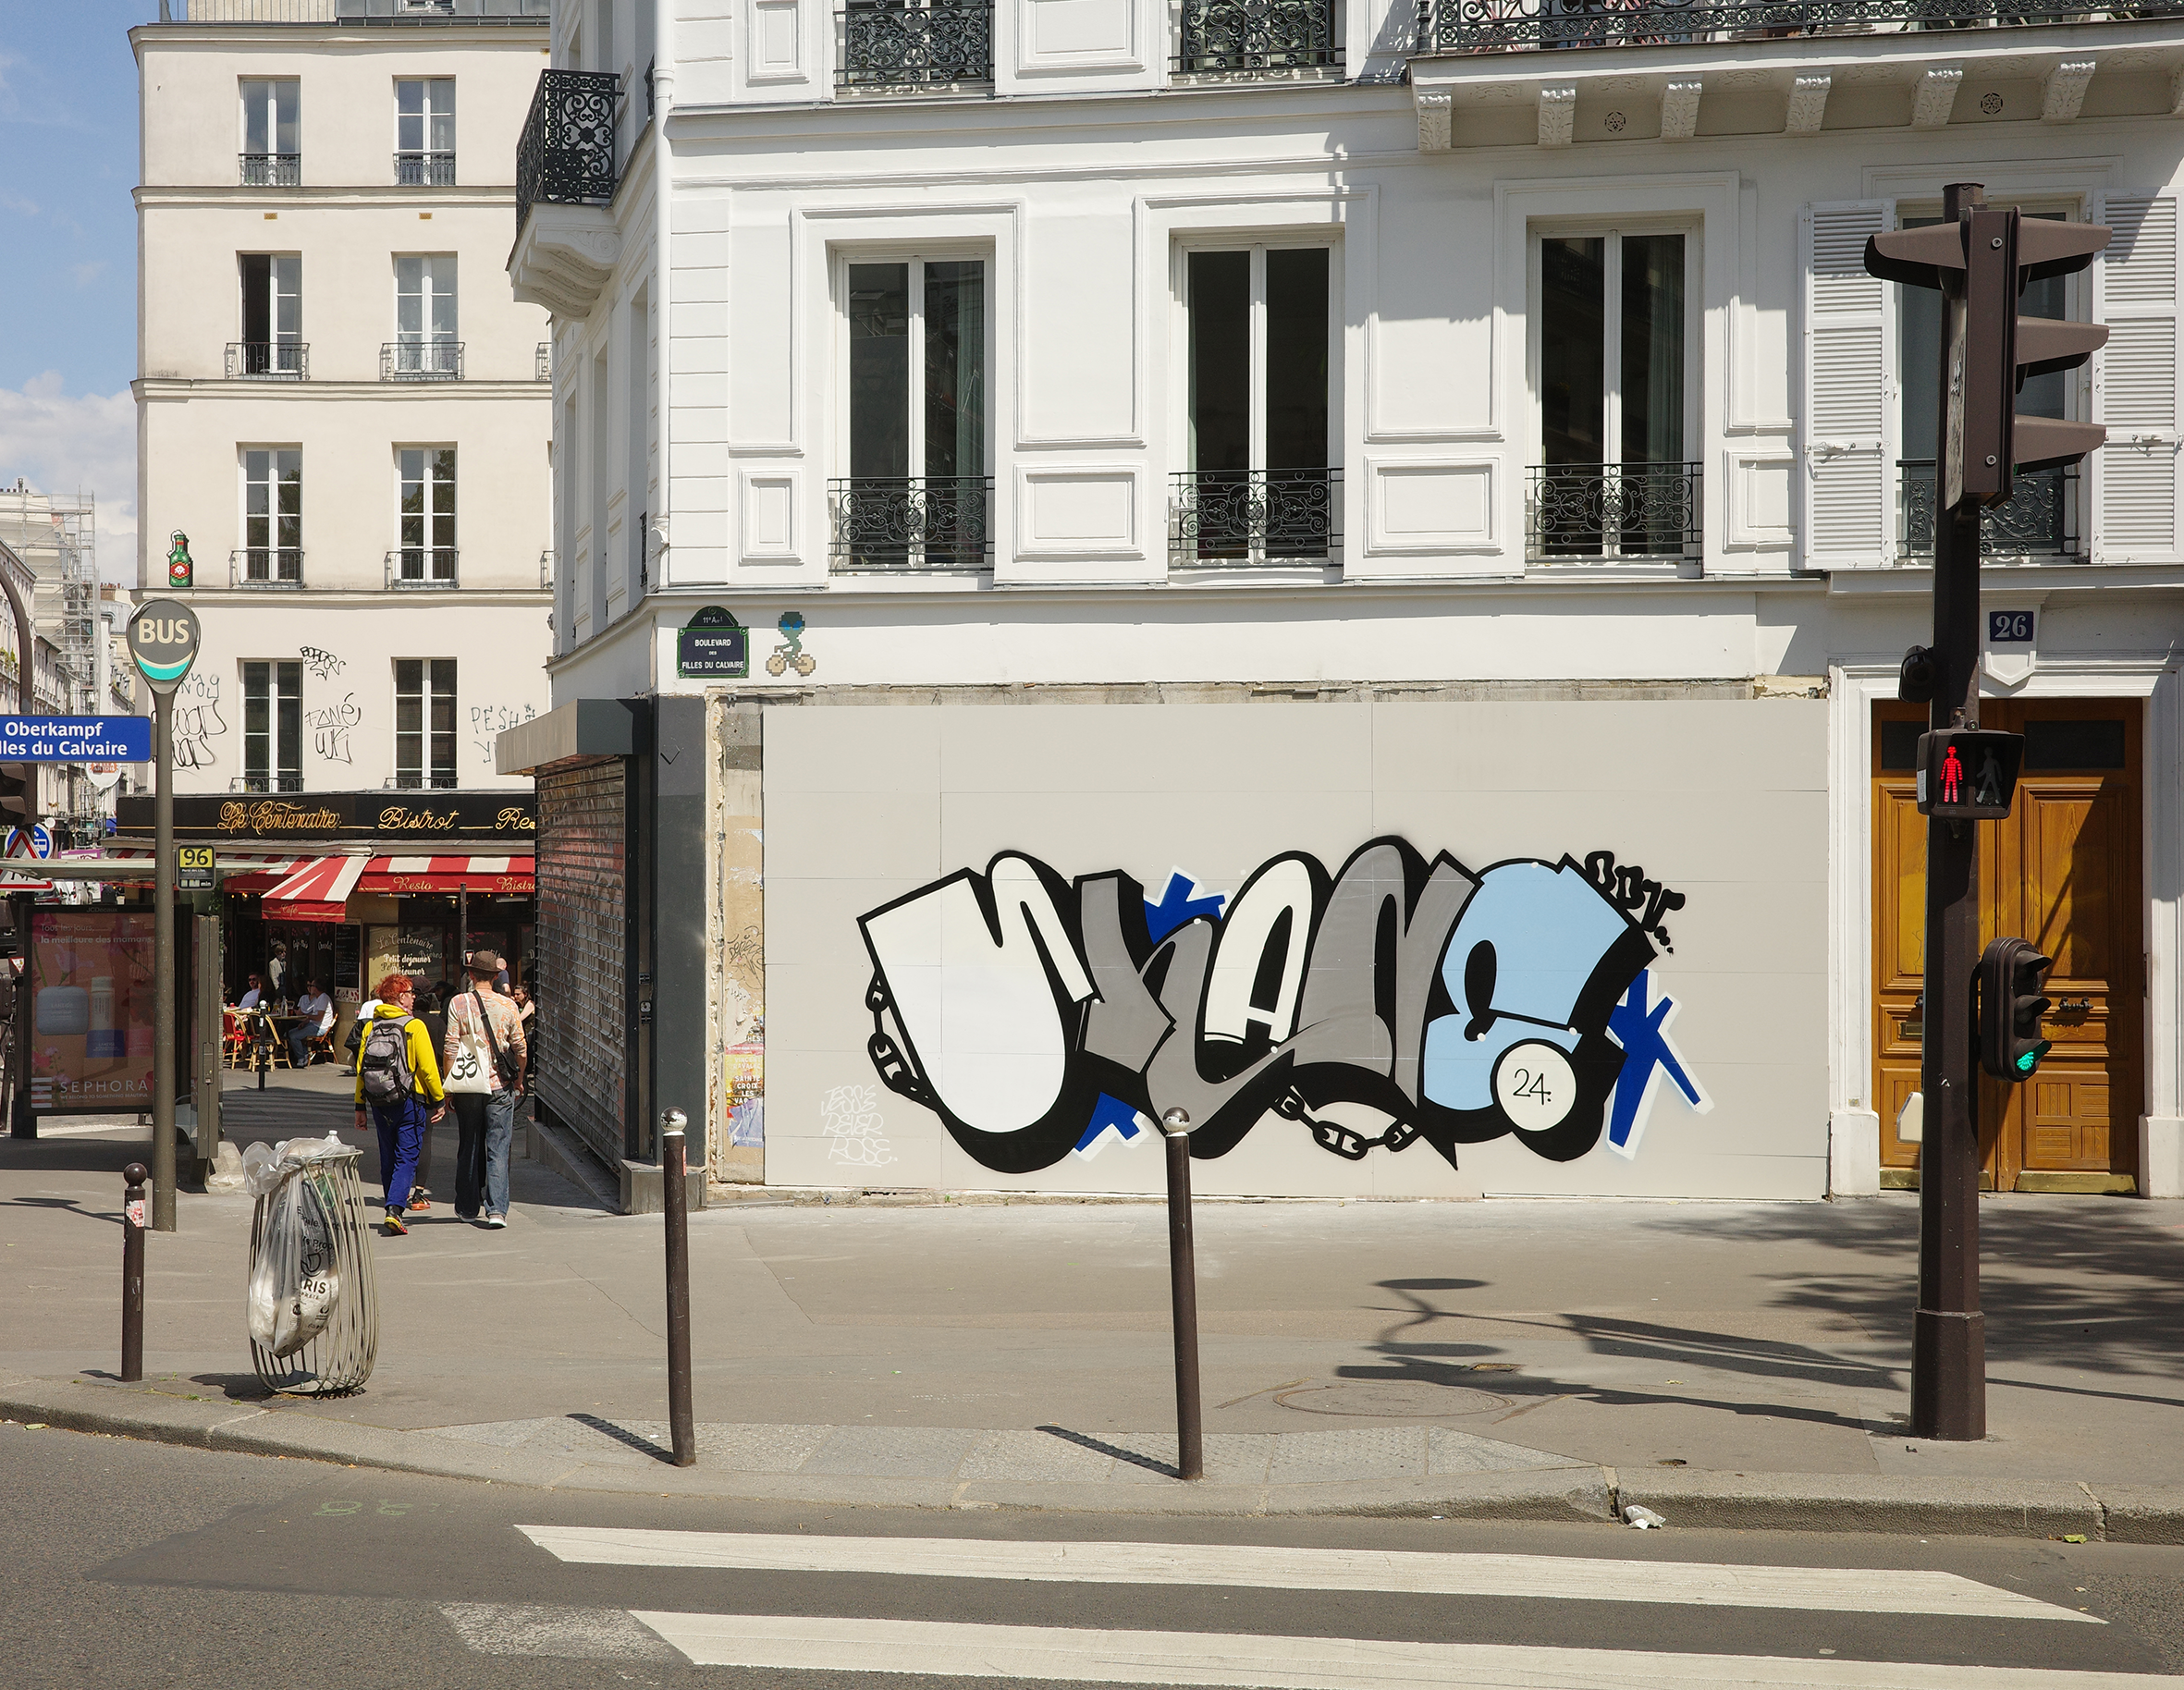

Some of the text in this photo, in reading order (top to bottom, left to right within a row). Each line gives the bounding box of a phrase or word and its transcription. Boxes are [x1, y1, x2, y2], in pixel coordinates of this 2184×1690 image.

[138, 618, 190, 644] BUS
[1994, 615, 2027, 639] 26
[694, 638, 731, 647] BOULEVARD
[681, 661, 744, 669] FILLES DU CALVAIRE
[5, 721, 104, 740] Oberkampf
[31, 741, 54, 755] du
[58, 741, 128, 755] Calvaire
[249, 800, 340, 836] Centenaire
[377, 806, 460, 830] Bistrot
[183, 848, 209, 866] 96
[393, 876, 434, 891] Resto
[280, 903, 299, 916] Café
[41, 924, 57, 932] Tous
[61, 924, 71, 932] les
[41, 936, 49, 944] la
[51, 936, 93, 944] meilleure
[95, 936, 111, 944] des
[388, 933, 434, 950] Centenaire
[383, 953, 400, 963] Petit
[60, 1080, 148, 1094] SEPHORA
